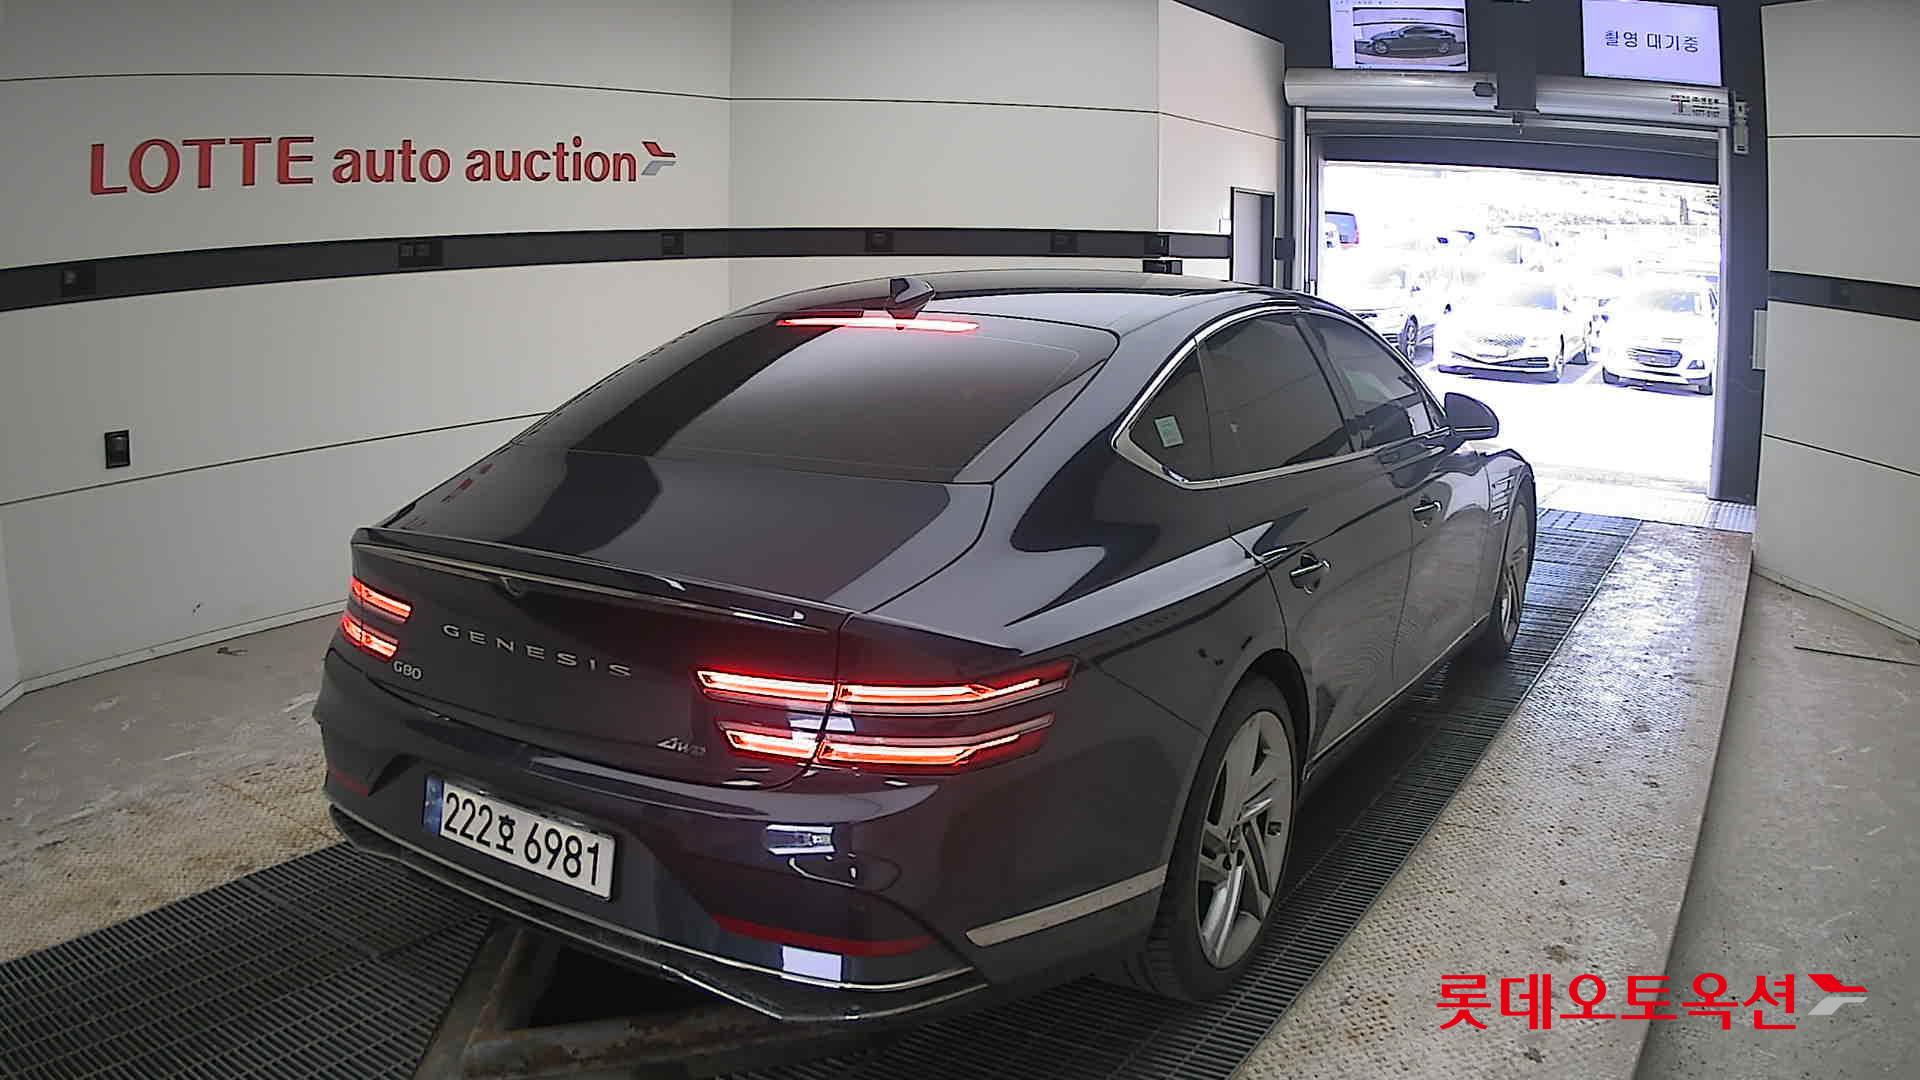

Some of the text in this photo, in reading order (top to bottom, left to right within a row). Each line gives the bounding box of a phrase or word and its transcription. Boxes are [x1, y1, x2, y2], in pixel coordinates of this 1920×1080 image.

[1646, 33, 1699, 53] 대기중
[90, 136, 638, 195] LOTTE auto auction
[393, 660, 422, 680] G80
[443, 624, 632, 678] GENESIS
[443, 792, 600, 886] 222호 6981
